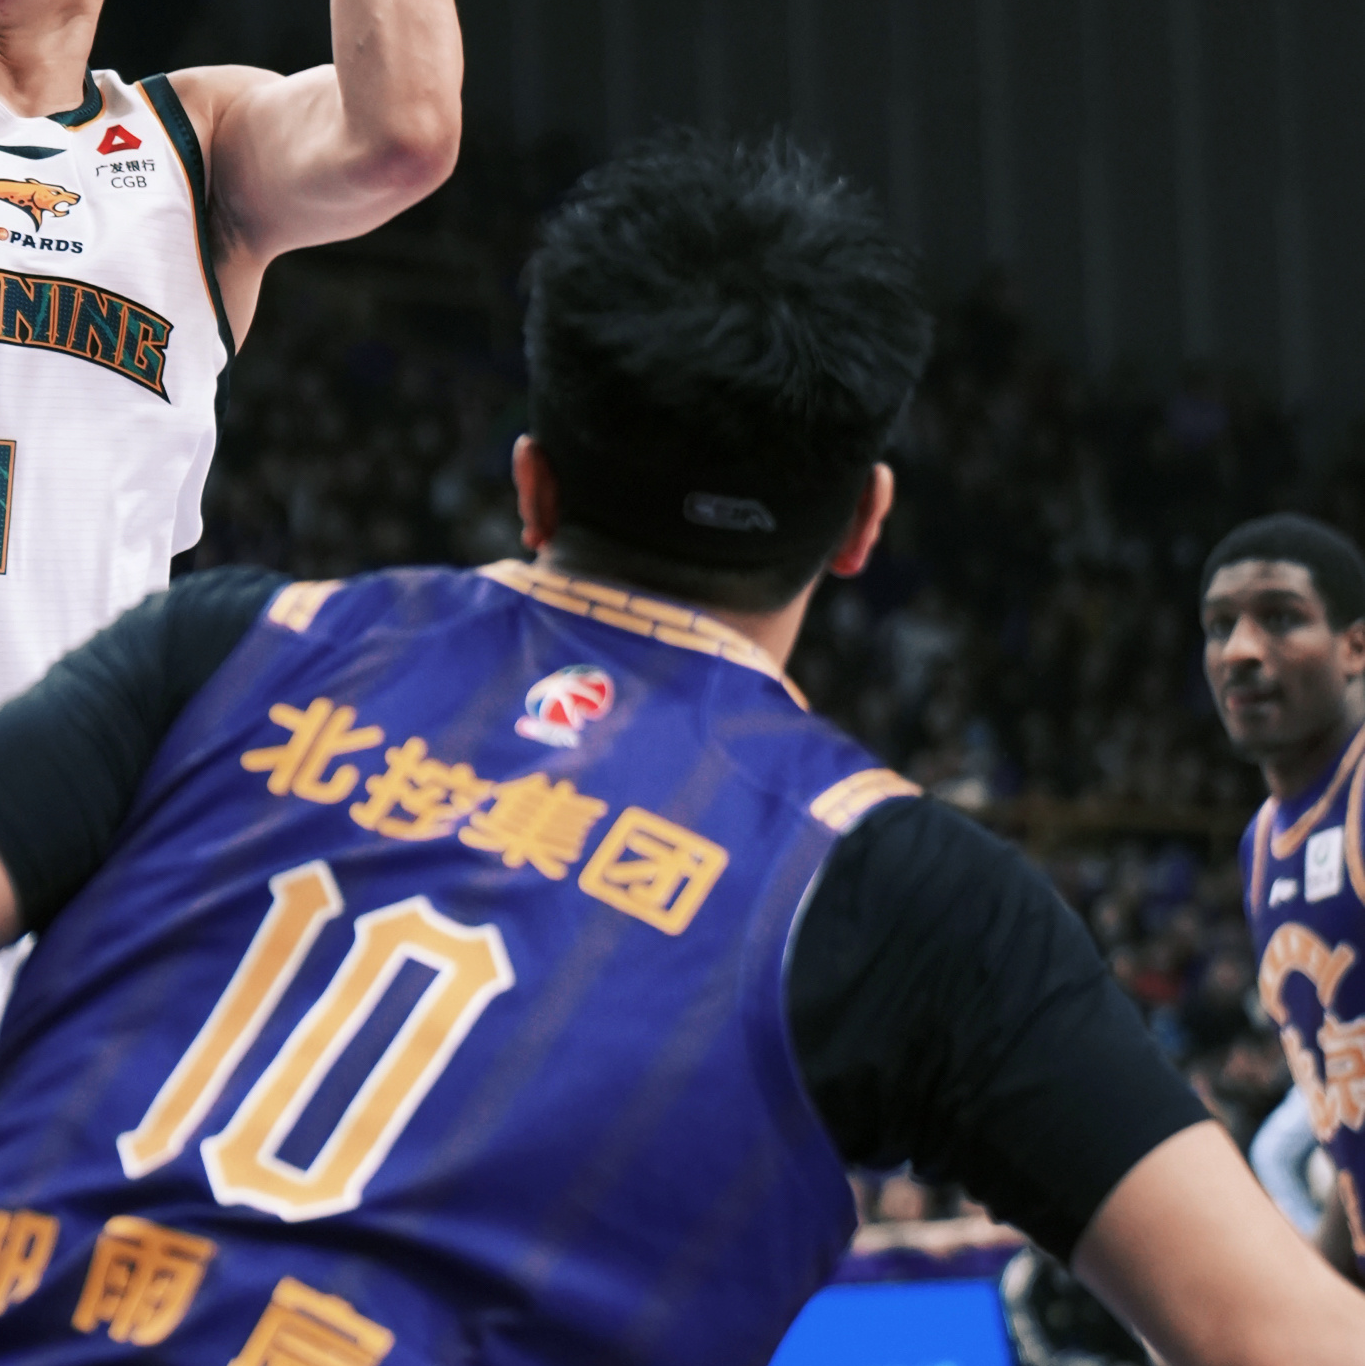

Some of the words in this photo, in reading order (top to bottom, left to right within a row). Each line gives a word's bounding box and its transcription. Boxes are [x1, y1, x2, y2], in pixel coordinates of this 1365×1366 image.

[95, 158, 156, 178] 广发银行
[110, 175, 148, 189] CGB
[241, 696, 730, 936] 北控集团
[116, 858, 516, 1223] 10
